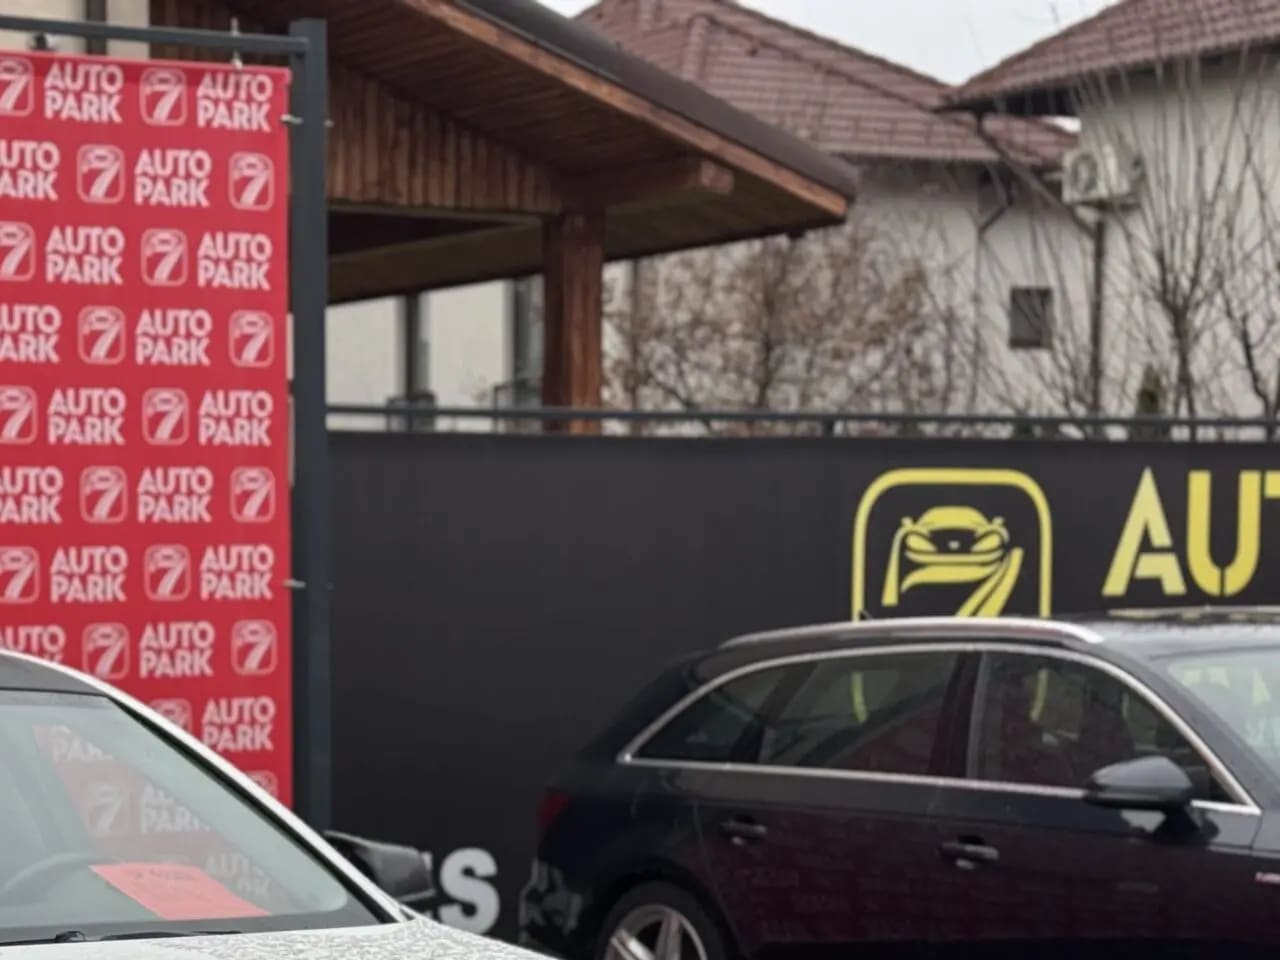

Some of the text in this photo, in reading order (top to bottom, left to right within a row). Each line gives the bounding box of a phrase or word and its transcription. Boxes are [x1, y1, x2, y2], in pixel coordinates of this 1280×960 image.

[44, 62, 123, 94] AUTO
[197, 73, 273, 103] AUTO
[45, 89, 122, 123] PARK
[198, 99, 270, 132] PARK
[135, 149, 212, 180] AUTO
[135, 175, 209, 207] PARK
[46, 225, 125, 257] AUTO
[198, 232, 272, 263] AUTO
[46, 252, 123, 284] PARK
[198, 258, 270, 290] PARK
[136, 309, 212, 338] AUTO
[136, 336, 210, 366] PARK
[48, 388, 126, 418] AUTO
[199, 390, 273, 418] AUTO
[48, 416, 125, 445] PARK
[199, 416, 271, 446] PARK
[138, 466, 213, 496] AUTO
[138, 494, 211, 522] PARK
[1101, 466, 1280, 597] AU
[50, 546, 128, 576] AUTO
[200, 544, 274, 574] AUTO
[51, 574, 126, 603] PARK
[201, 572, 272, 600] PARK
[140, 621, 215, 651] AUTO
[140, 649, 213, 678] PARK
[203, 696, 276, 726] AUTO
[203, 724, 273, 751] PARK
